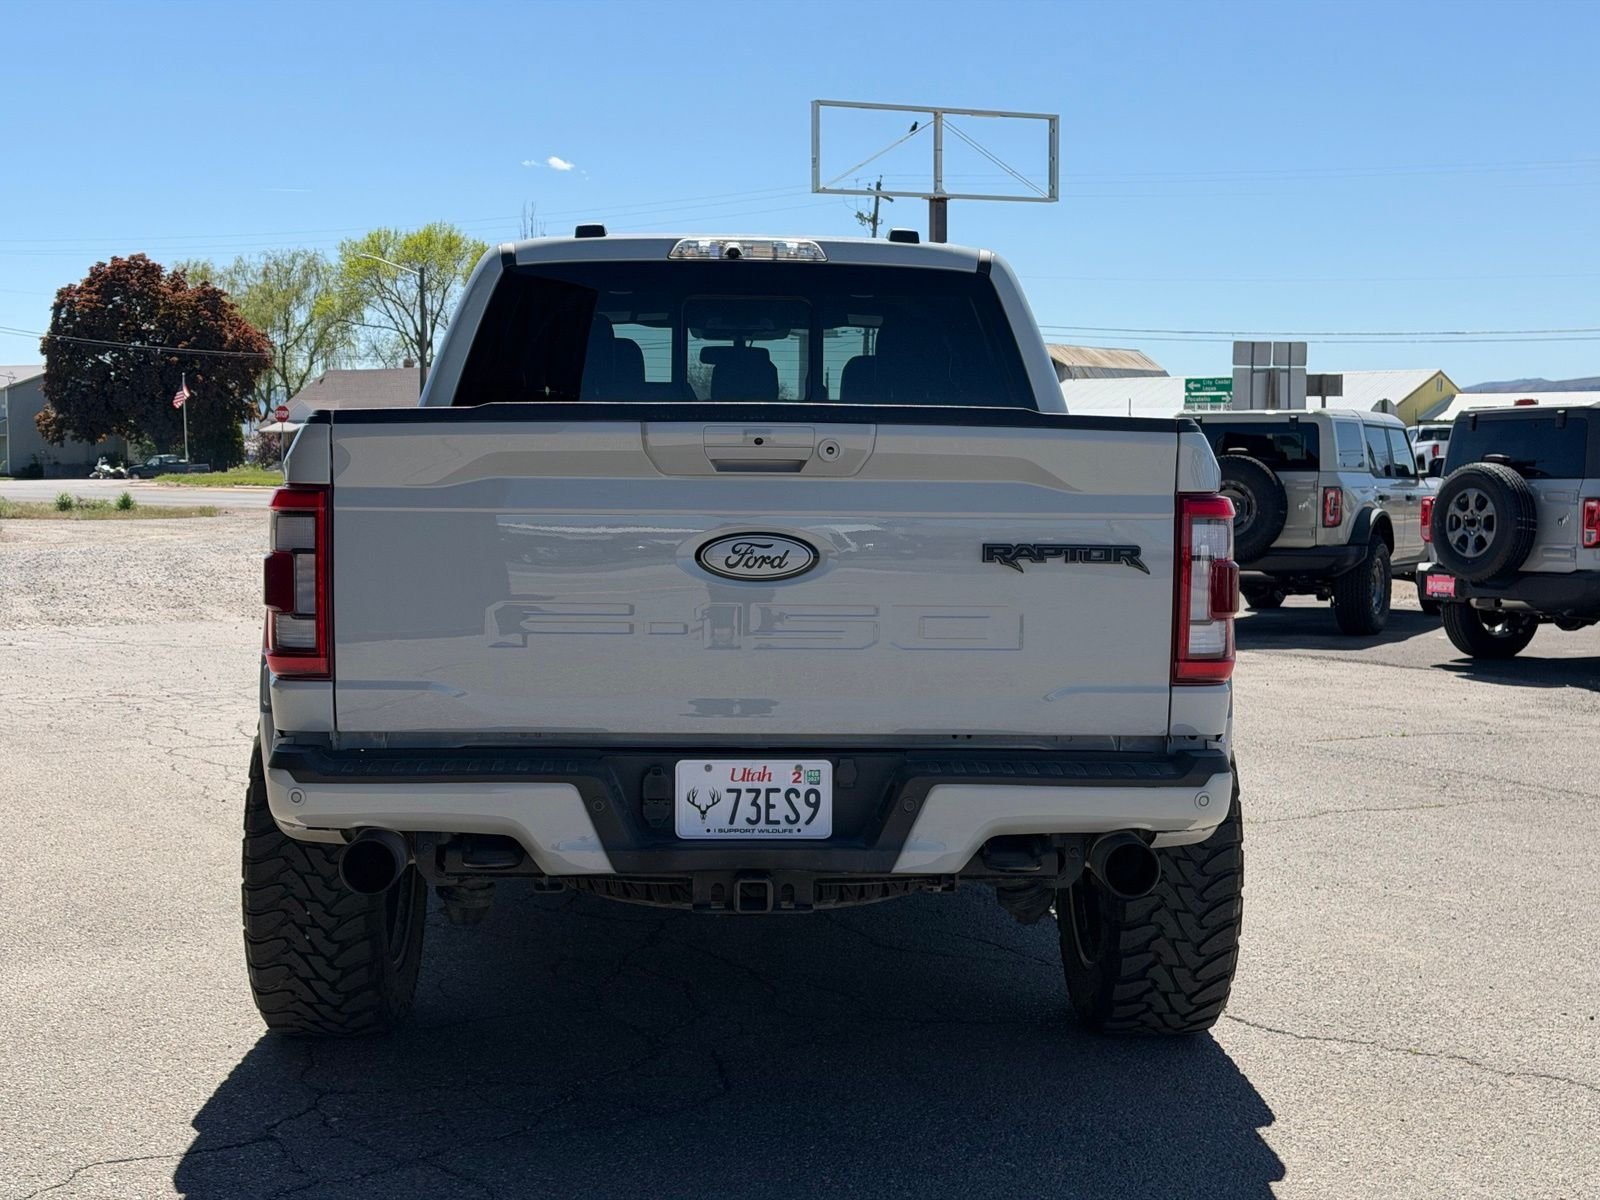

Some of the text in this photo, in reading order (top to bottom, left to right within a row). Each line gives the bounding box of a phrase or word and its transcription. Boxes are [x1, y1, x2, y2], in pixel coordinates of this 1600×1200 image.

[275, 410, 289, 418] STOP
[724, 541, 791, 570] Ford
[982, 543, 1151, 575] RAPTOR
[729, 765, 773, 783] Utah
[791, 771, 803, 784] 2
[726, 787, 821, 826] 73ES9
